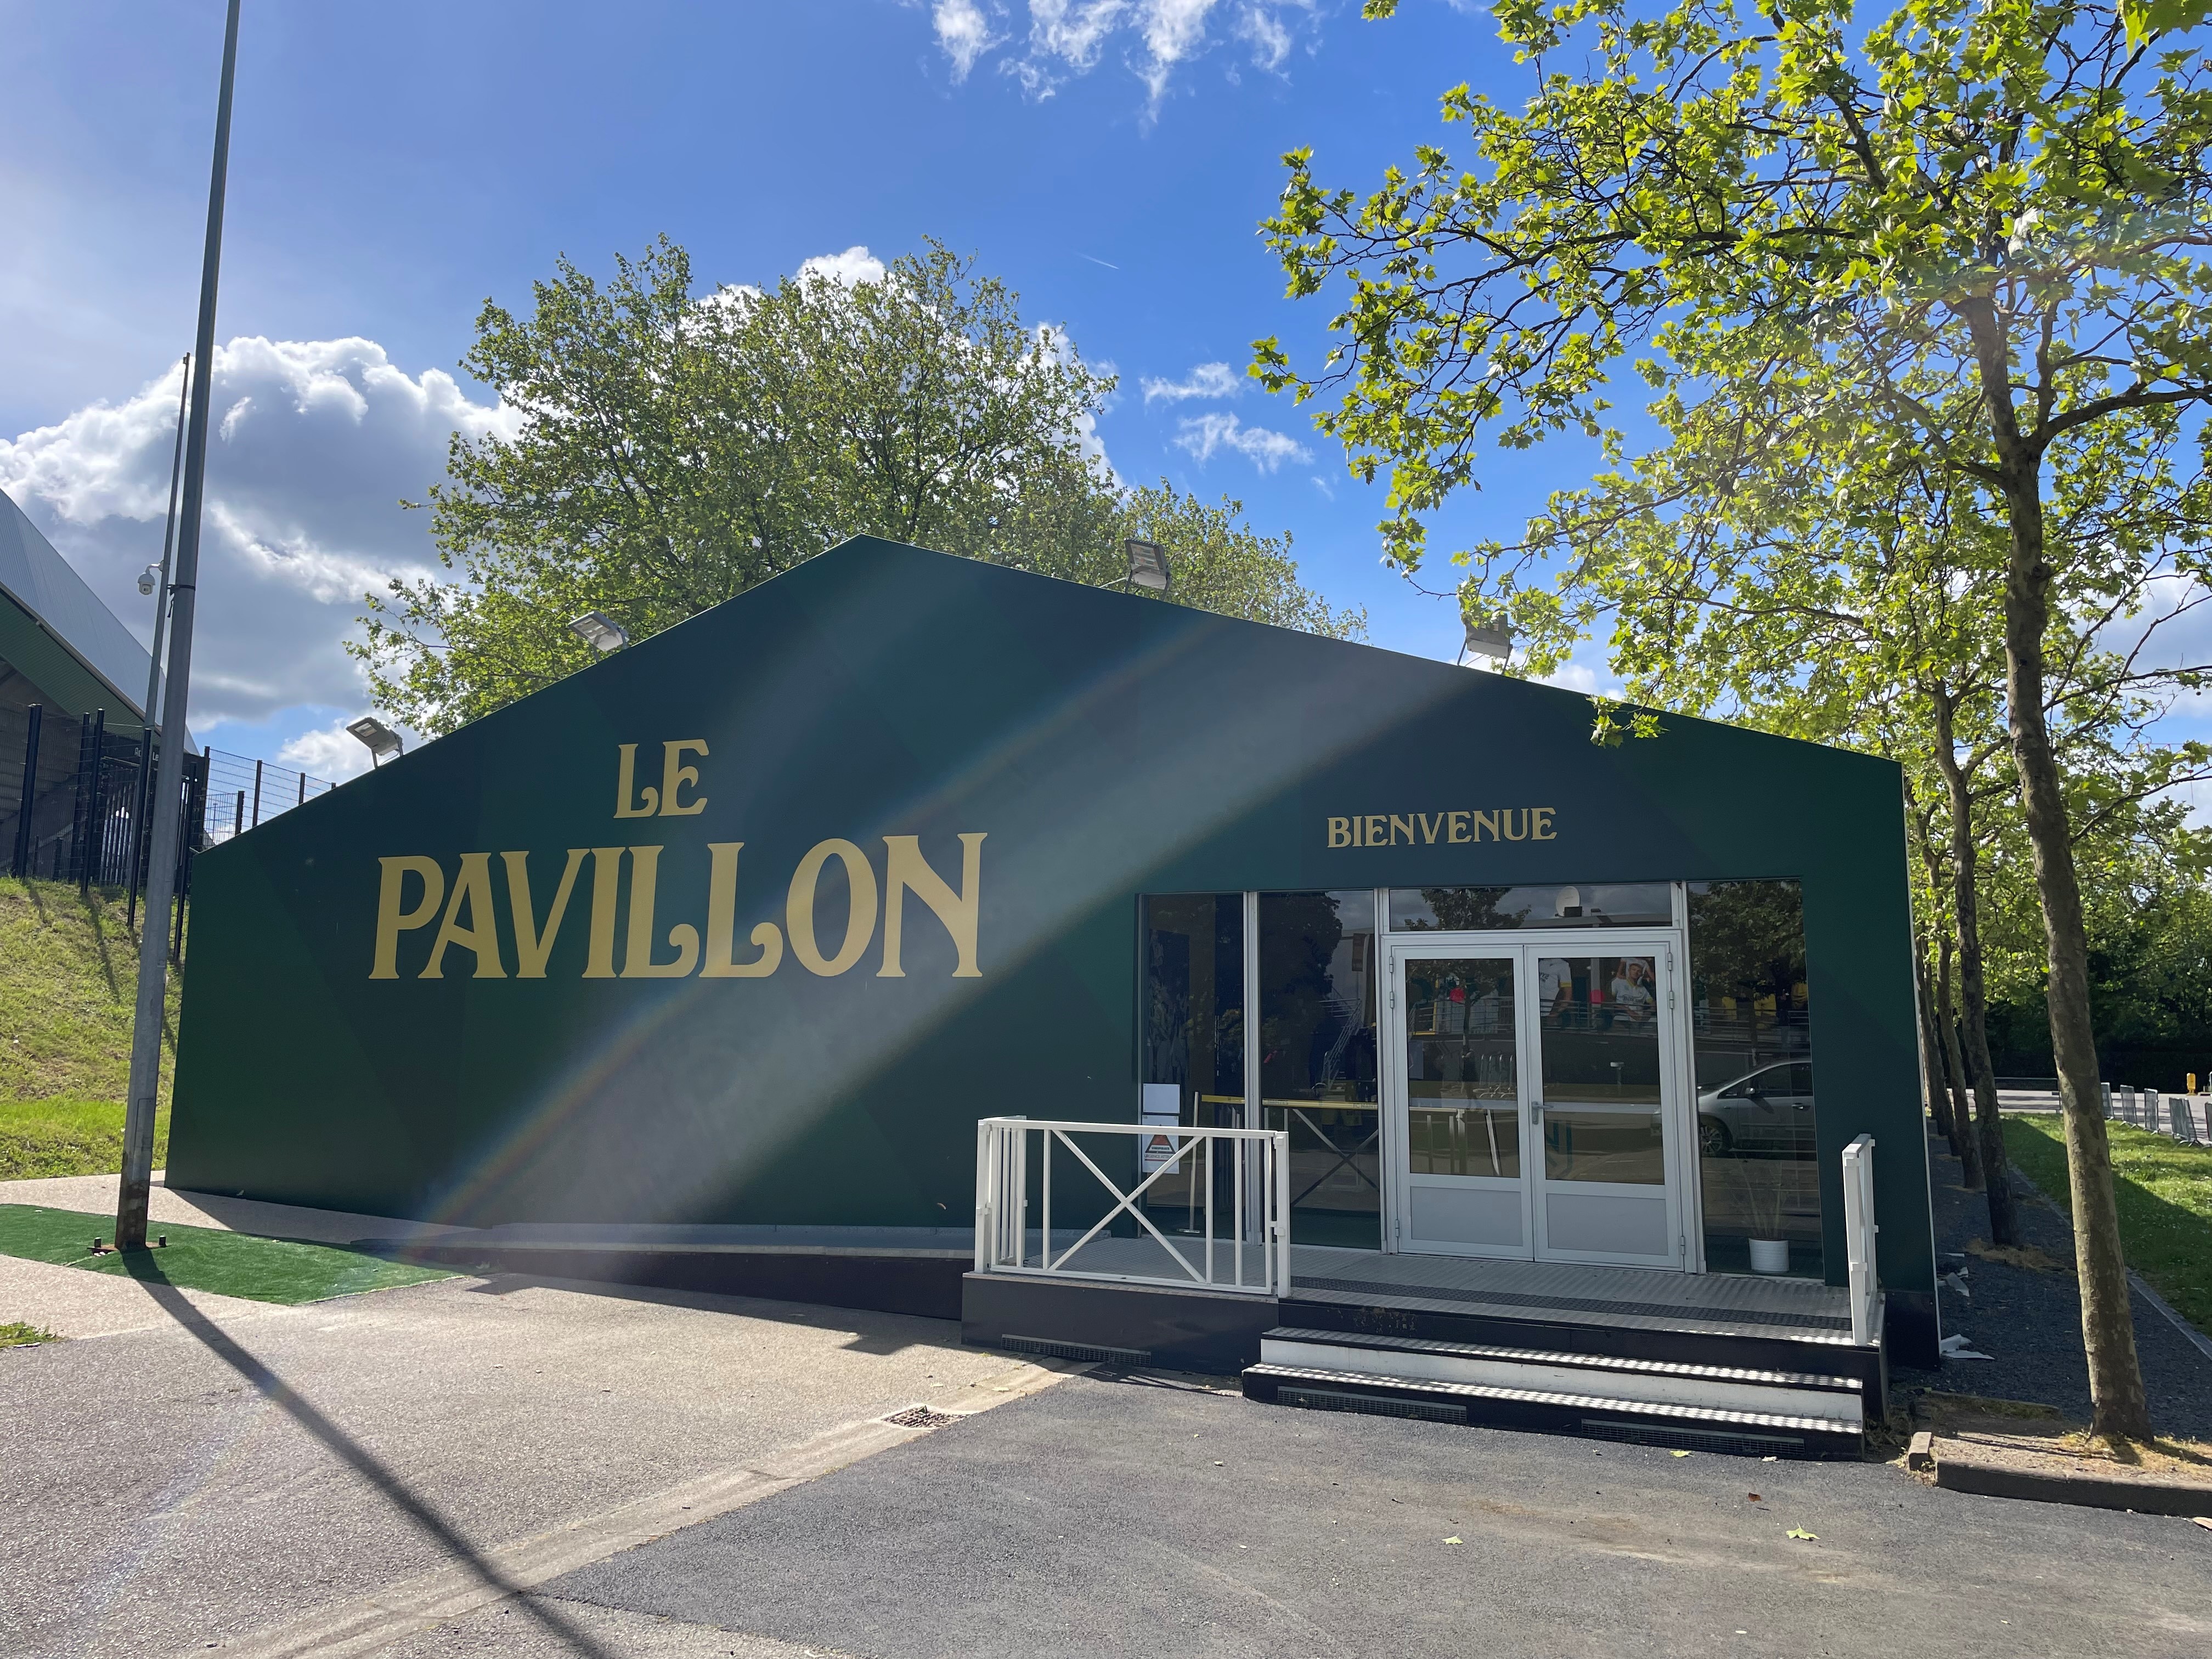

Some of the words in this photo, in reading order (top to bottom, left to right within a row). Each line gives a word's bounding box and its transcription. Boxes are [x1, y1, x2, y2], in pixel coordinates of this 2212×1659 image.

[613, 738, 709, 818] LE
[1327, 807, 1558, 848] BIENVENUE
[368, 832, 988, 979] PAVILLON
